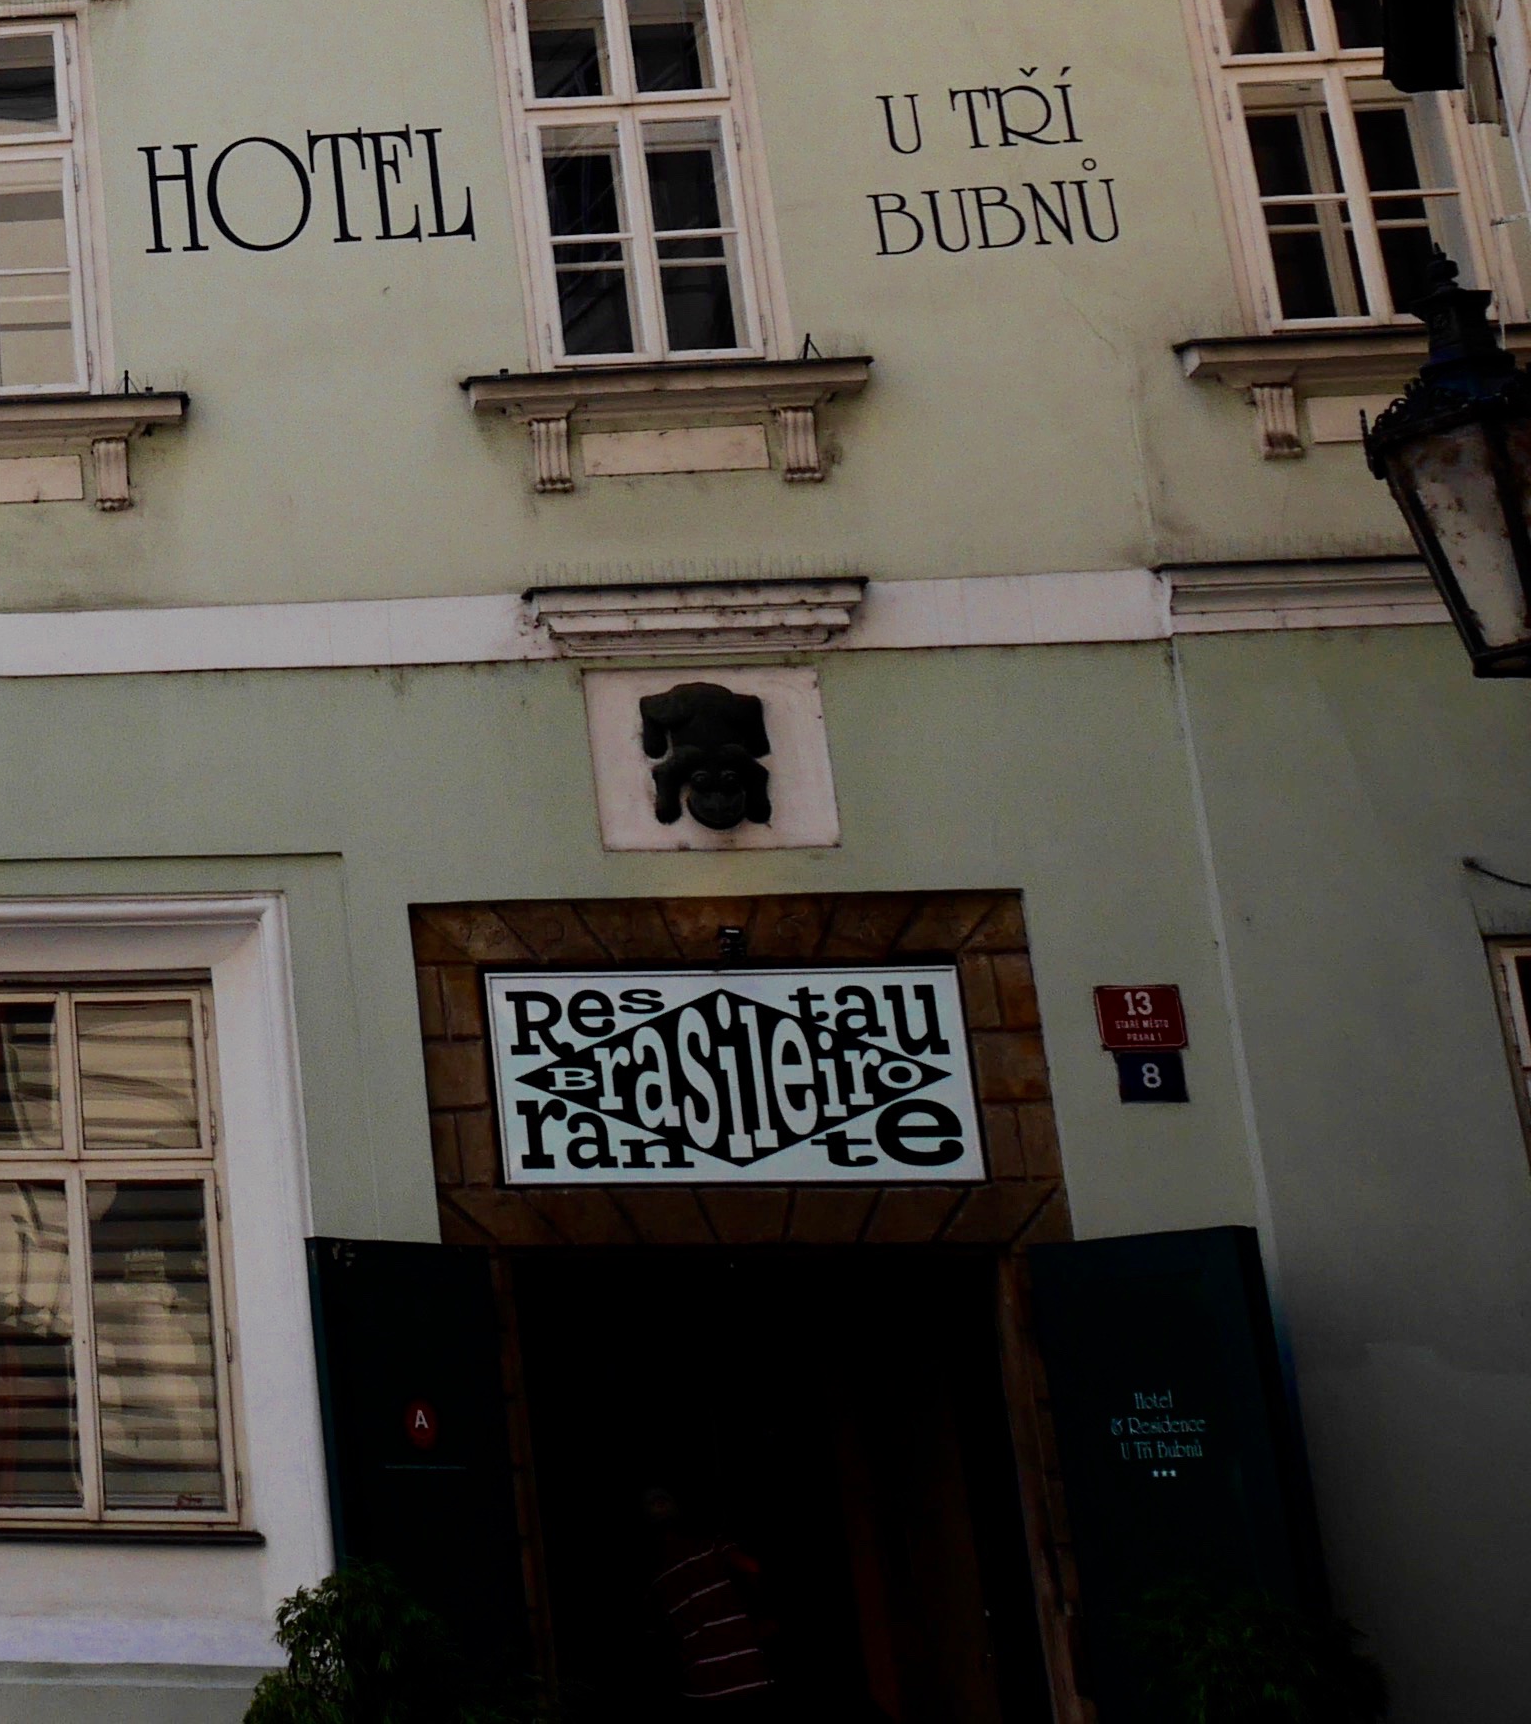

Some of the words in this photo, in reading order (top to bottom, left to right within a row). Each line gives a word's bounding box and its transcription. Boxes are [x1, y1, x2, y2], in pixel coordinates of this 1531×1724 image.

[875, 92, 924, 155] U
[949, 66, 1085, 150] TŘÍ
[138, 122, 476, 255] HOTEL
[865, 157, 1121, 257] BUBNŮ
[1123, 990, 1153, 1016] 13
[546, 992, 923, 1159] Brasileiro
[1141, 1062, 1162, 1089] 8
[1133, 1388, 1174, 1410] Hotel
[413, 1408, 430, 1430] A
[1126, 1413, 1207, 1436] Residence
[1119, 1441, 1130, 1461] U
